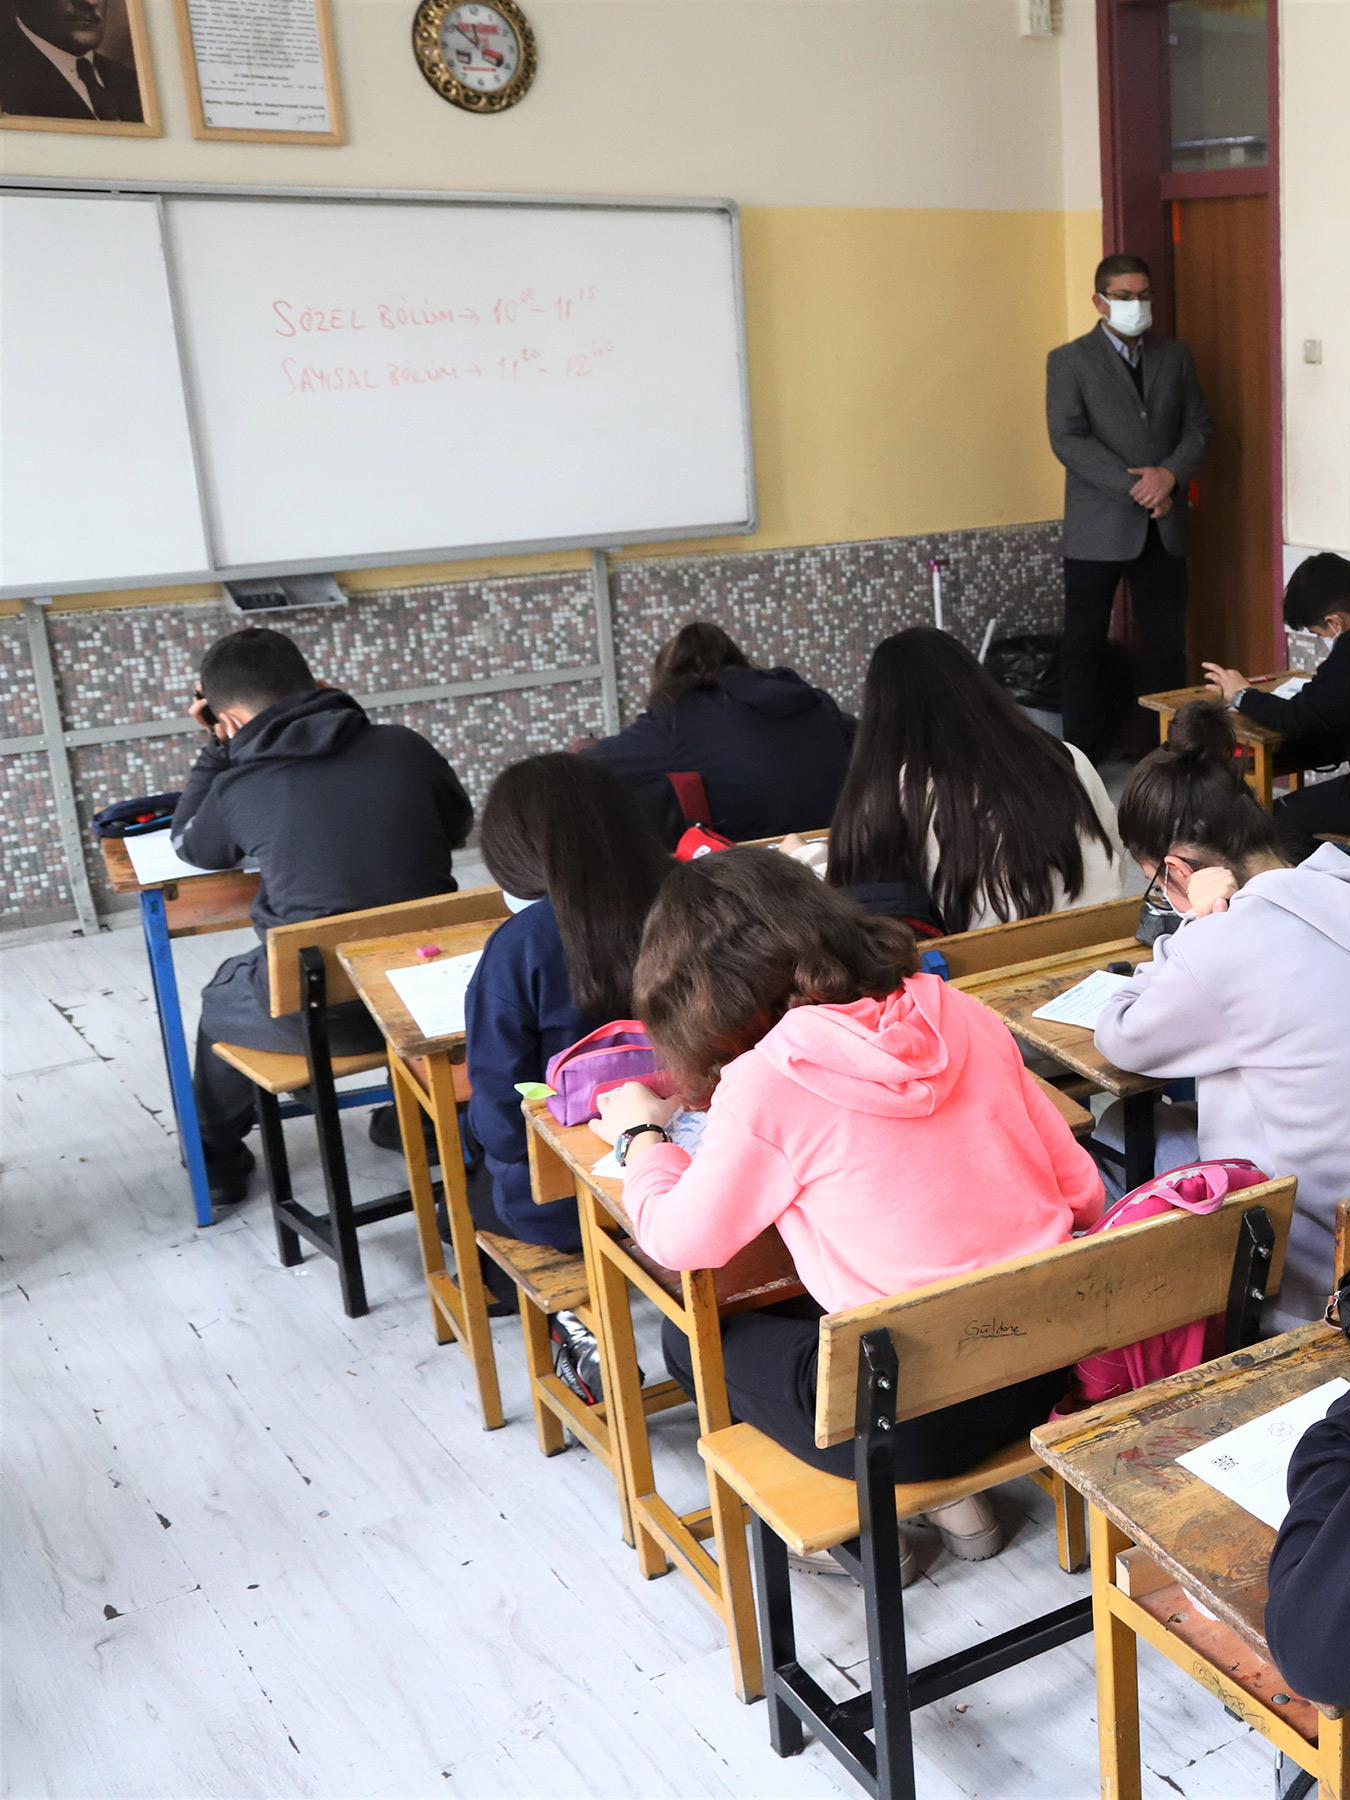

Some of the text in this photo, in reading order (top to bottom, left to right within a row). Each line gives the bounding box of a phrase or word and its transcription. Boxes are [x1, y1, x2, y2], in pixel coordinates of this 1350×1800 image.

[272, 300, 365, 337] SÖZEL
[377, 297, 455, 330] BÖLÜM
[281, 356, 380, 396] SAYISAL
[388, 359, 458, 387] BÖLÜM
